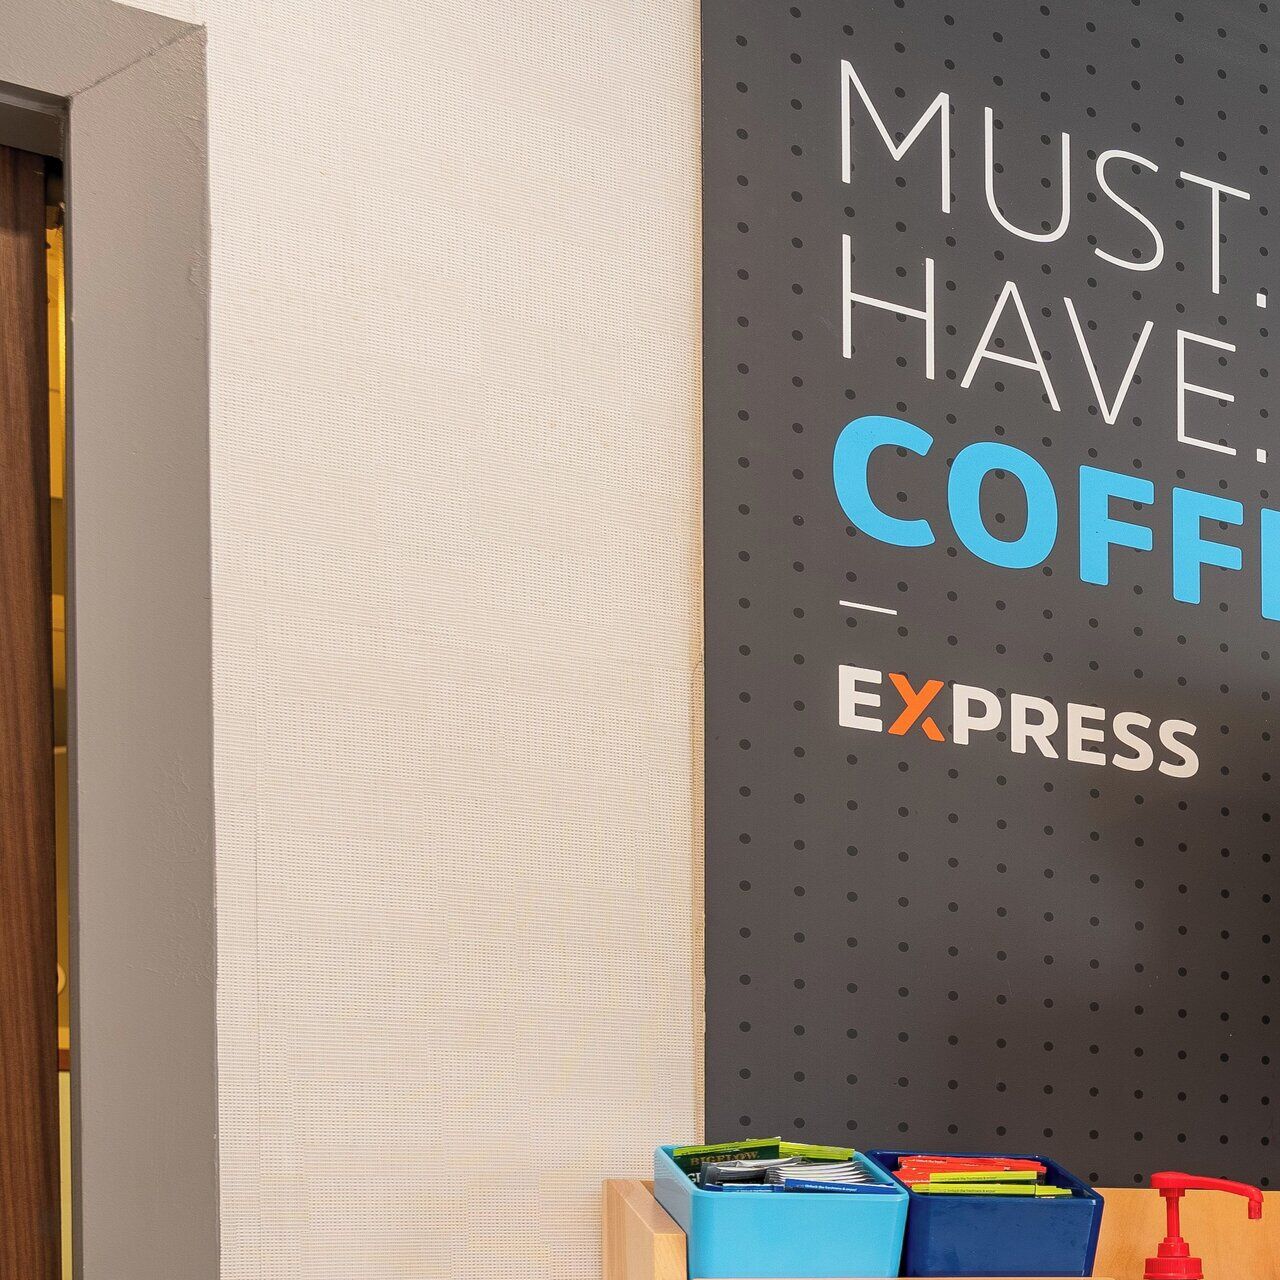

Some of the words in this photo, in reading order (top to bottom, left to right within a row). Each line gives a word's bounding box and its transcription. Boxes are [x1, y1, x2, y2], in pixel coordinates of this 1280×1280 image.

[840, 59, 1268, 308] MUST.
[841, 233, 1267, 463] HAVE.
[838, 664, 1200, 779] EXPRESS
